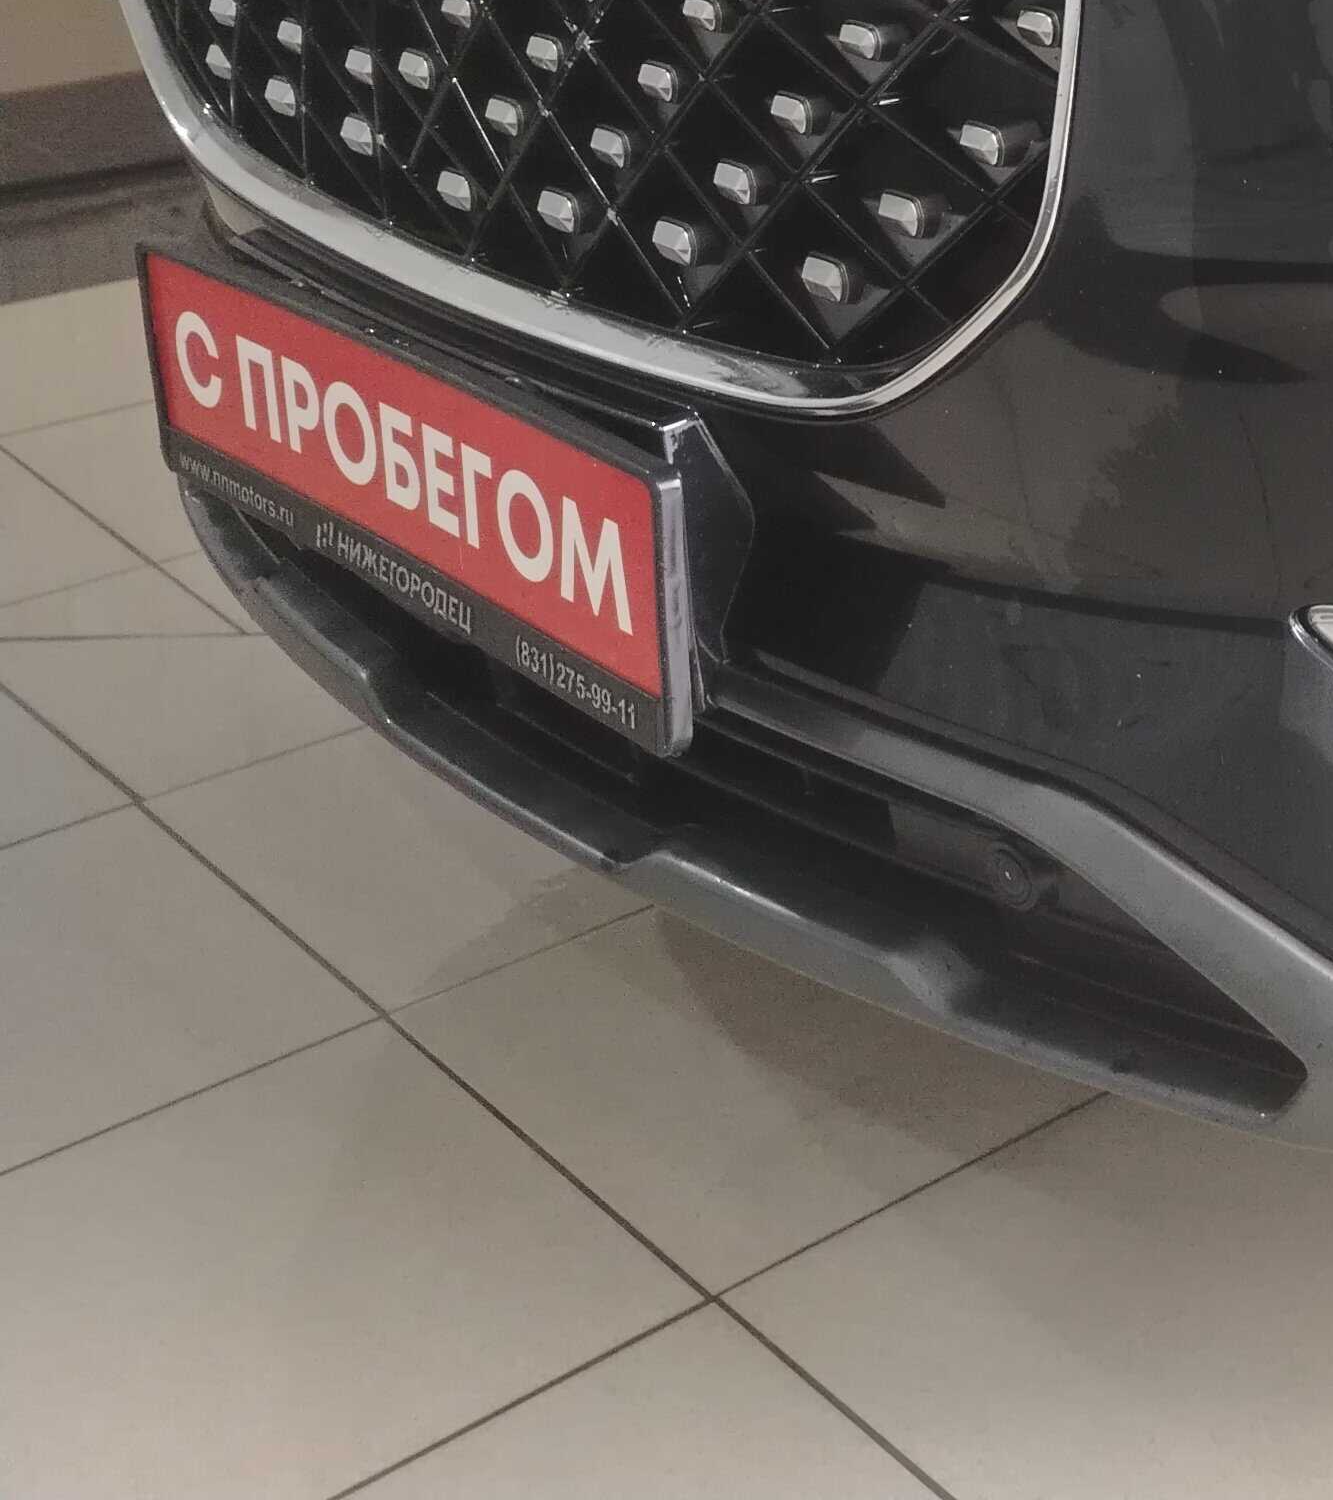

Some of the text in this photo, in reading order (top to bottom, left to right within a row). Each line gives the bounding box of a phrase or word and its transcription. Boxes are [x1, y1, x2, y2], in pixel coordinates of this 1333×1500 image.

[175, 311, 633, 635] С ПРОБЕГОМ
[179, 455, 294, 527] www.nnmotors.ru
[337, 530, 473, 636] НИЖЕГОРОДЕЦ
